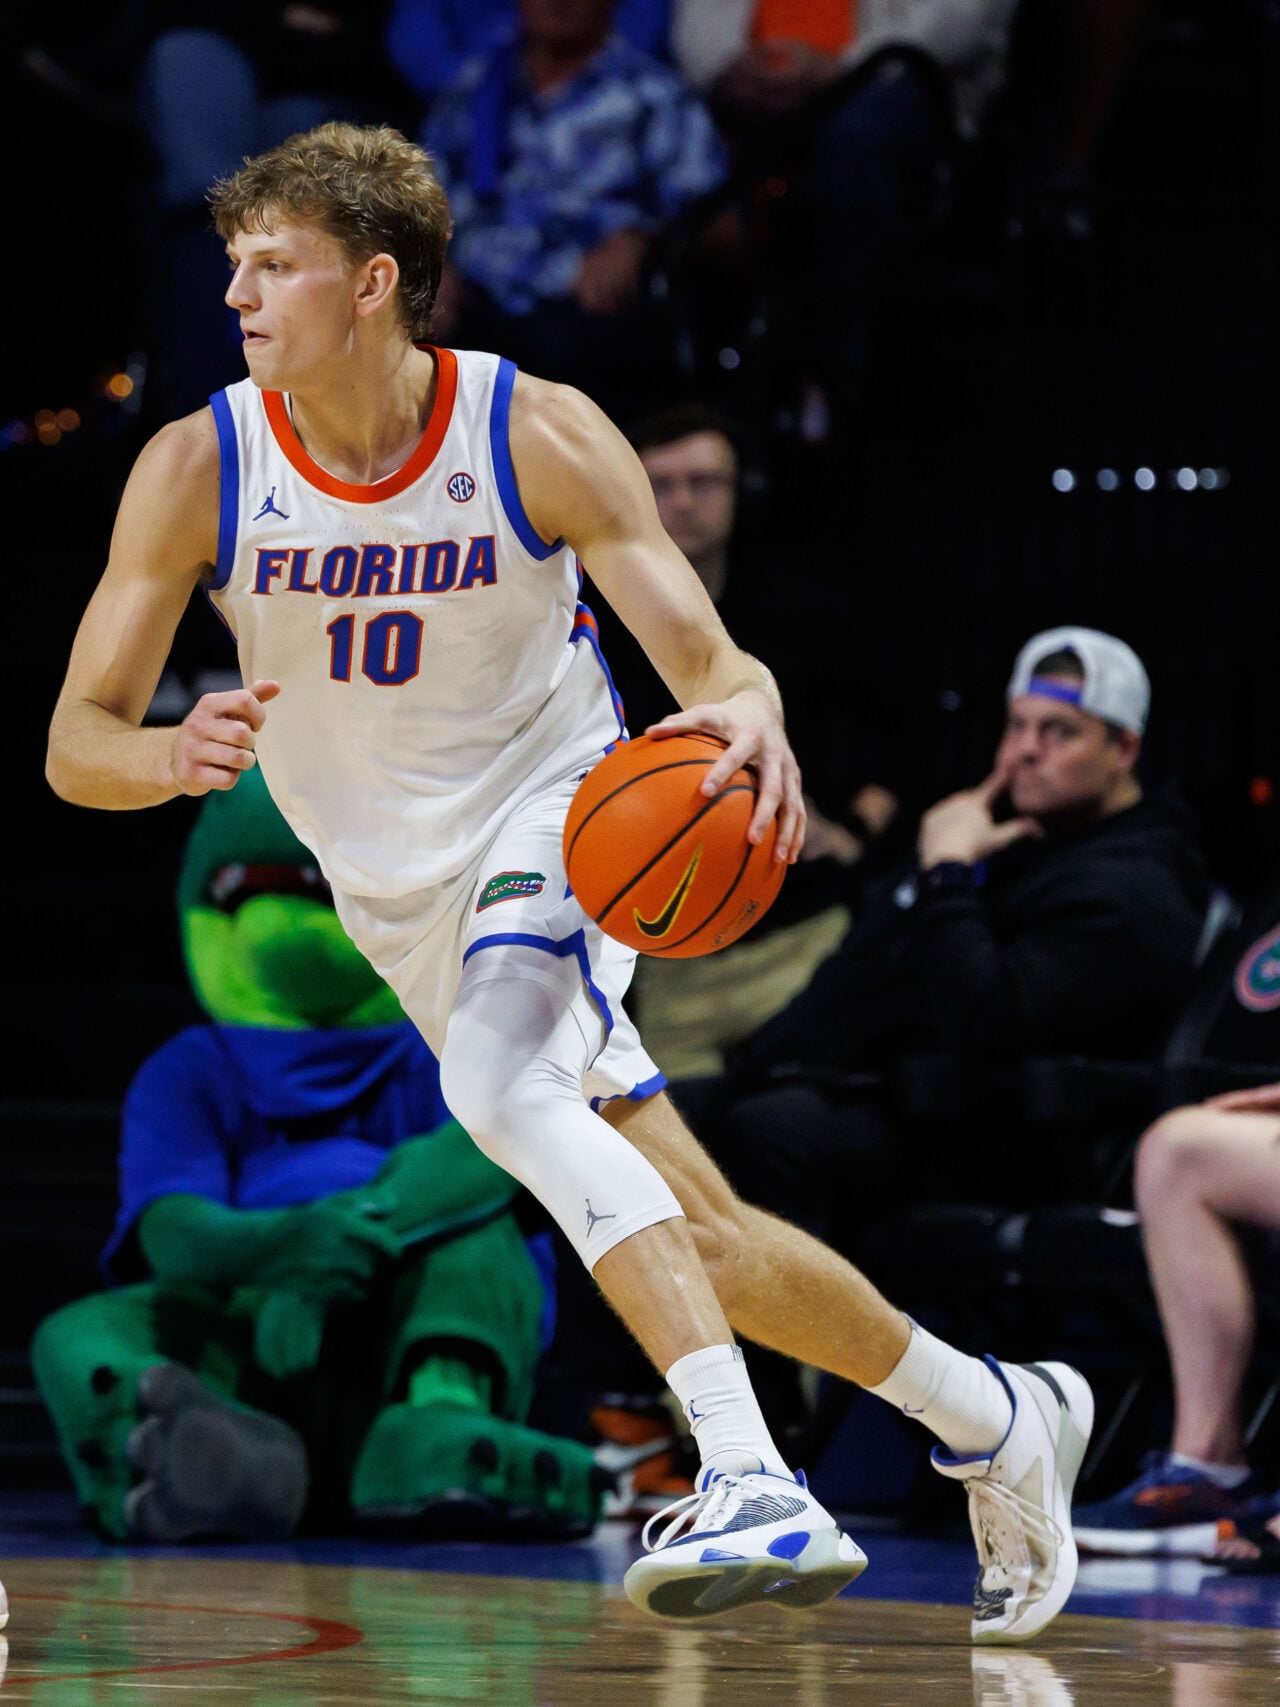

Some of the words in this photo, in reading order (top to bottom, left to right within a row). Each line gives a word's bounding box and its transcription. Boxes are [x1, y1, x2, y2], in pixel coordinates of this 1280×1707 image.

[449, 474, 474, 501] SEC
[251, 535, 498, 598] FLORIDA
[326, 610, 424, 687] 10
